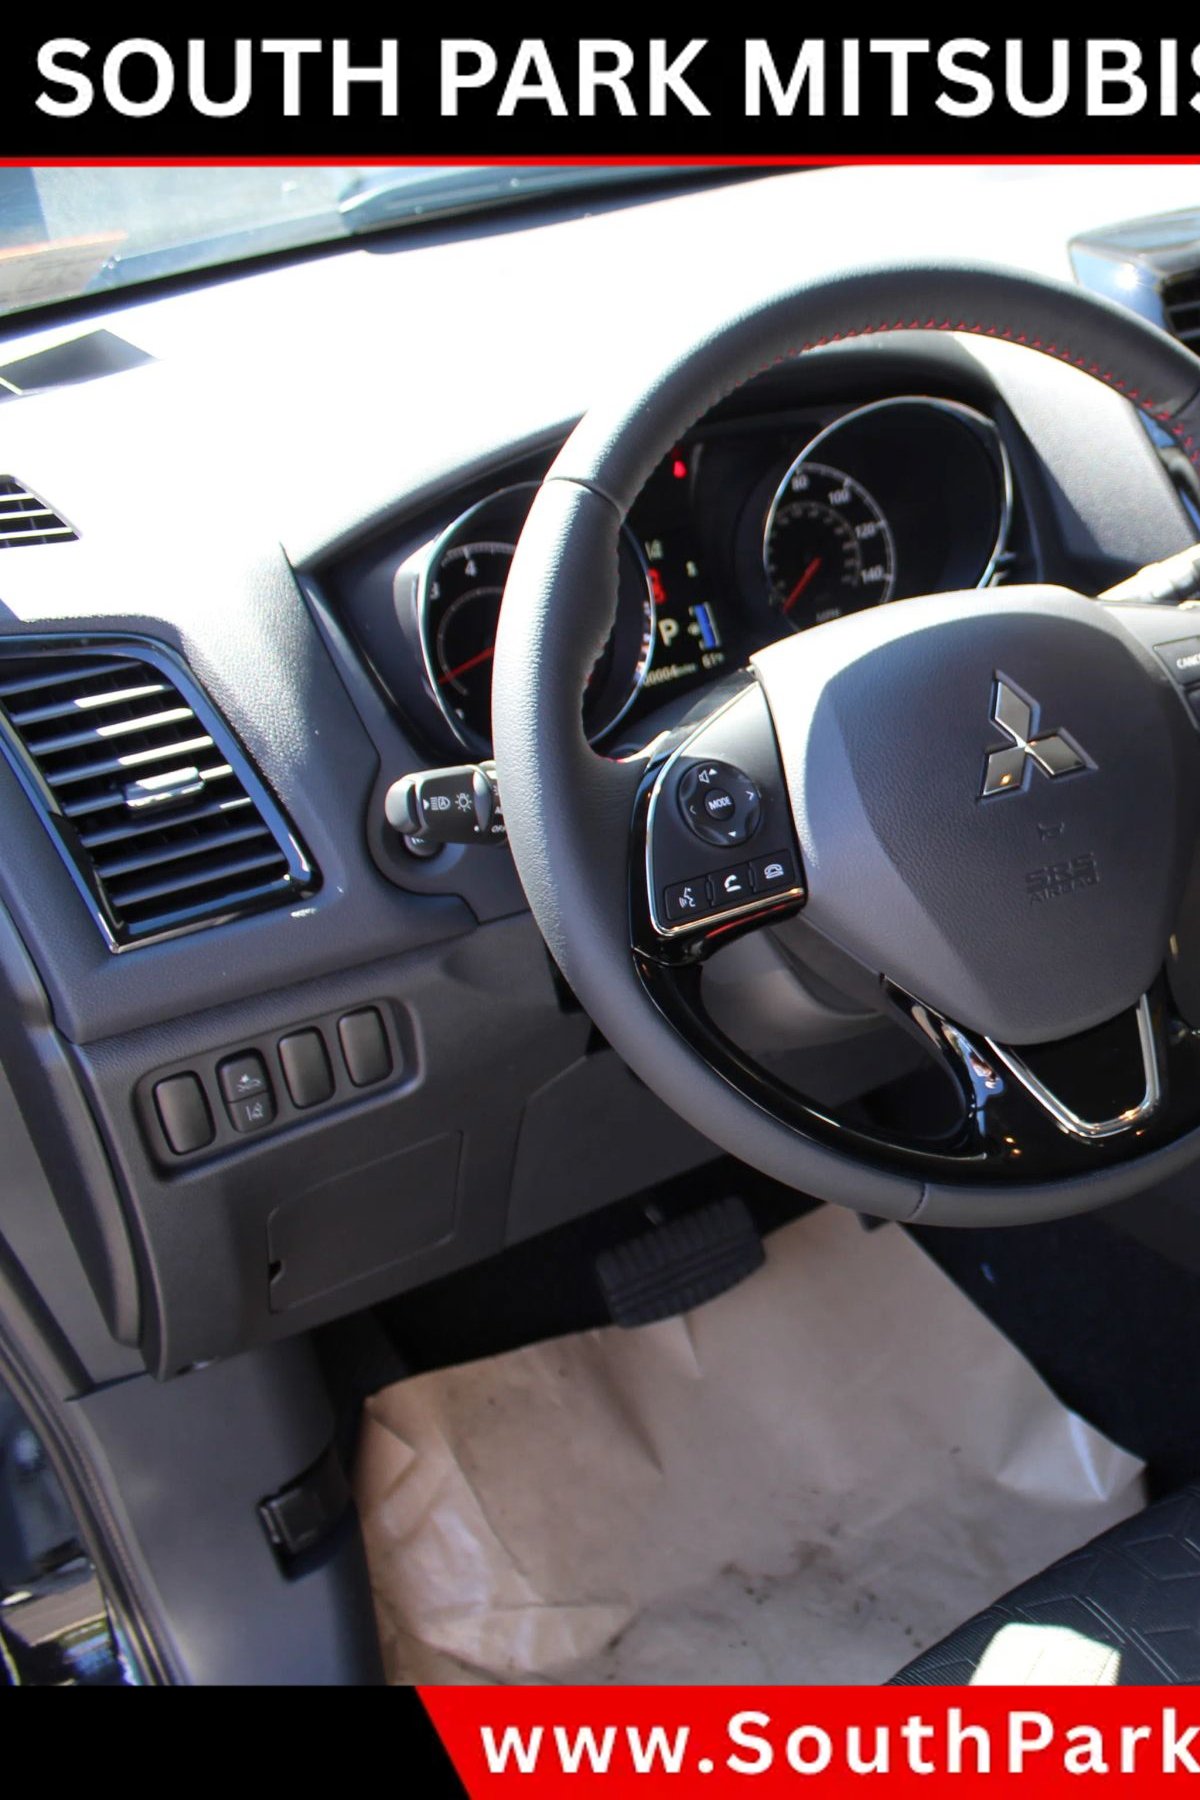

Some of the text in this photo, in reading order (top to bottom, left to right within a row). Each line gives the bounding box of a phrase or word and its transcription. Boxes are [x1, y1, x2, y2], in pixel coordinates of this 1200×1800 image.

[828, 489, 851, 504] 100
[855, 523, 875, 538] 120
[465, 560, 477, 576] 4
[861, 565, 885, 583] 140
[658, 618, 679, 646] P
[708, 796, 732, 810] MODE
[1025, 852, 1098, 894] SRS
